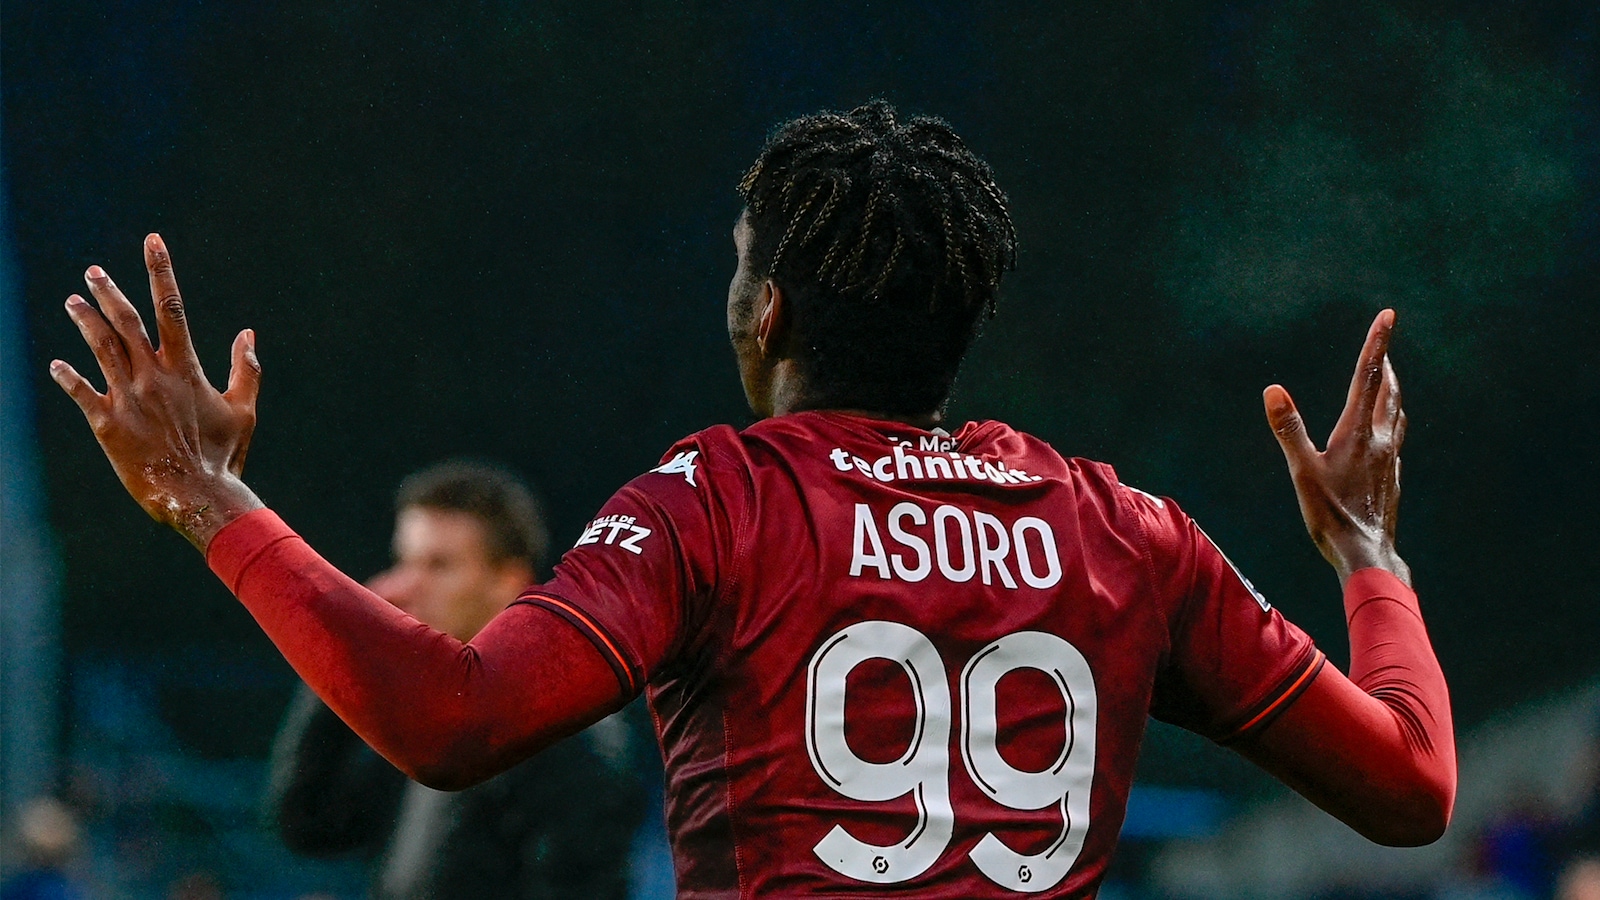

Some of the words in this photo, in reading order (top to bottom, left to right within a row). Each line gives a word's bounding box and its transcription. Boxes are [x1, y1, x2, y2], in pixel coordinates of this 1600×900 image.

[619, 515, 637, 525] DE
[849, 502, 1062, 589] ASORO
[805, 620, 1098, 893] 99
